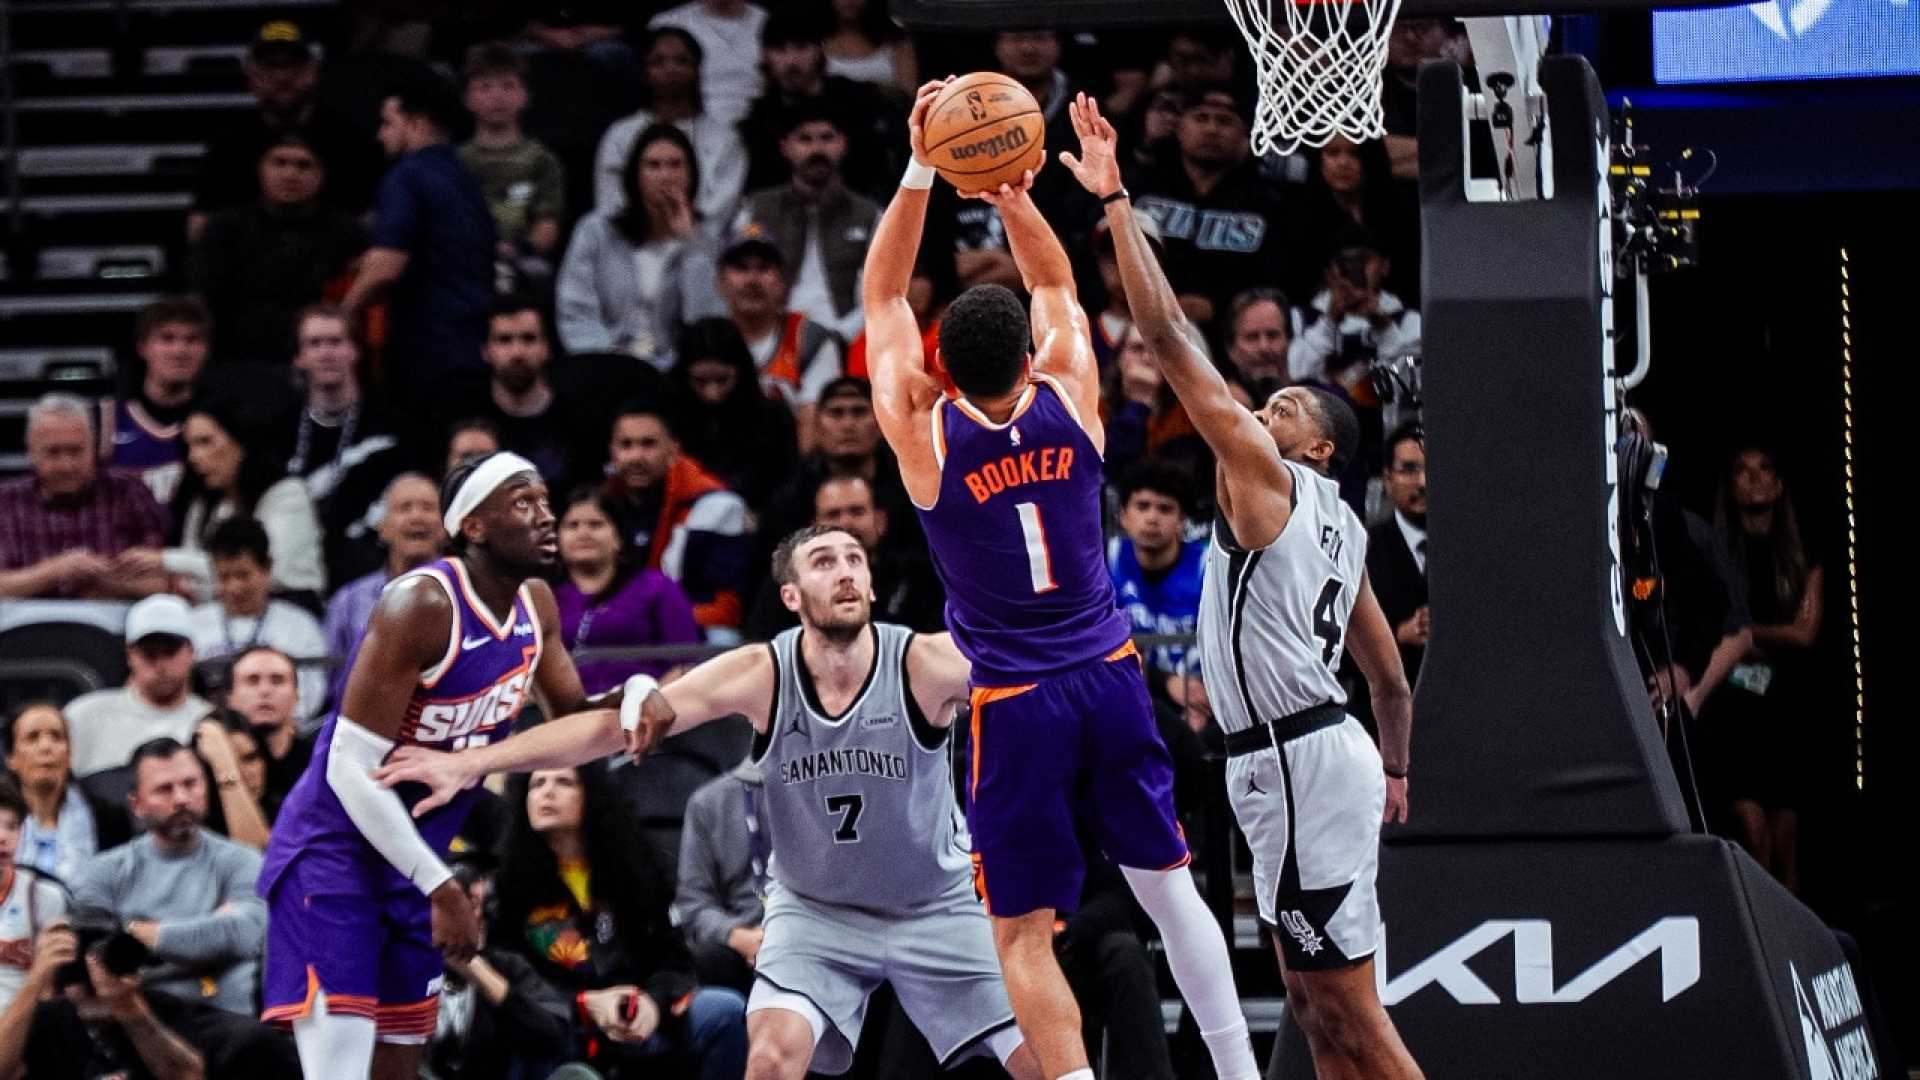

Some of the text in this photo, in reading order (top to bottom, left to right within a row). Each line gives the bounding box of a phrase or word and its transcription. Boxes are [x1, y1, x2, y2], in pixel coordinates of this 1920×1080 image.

[950, 125, 1029, 160] Wilson
[964, 447, 1074, 505] BOOKER
[1014, 502, 1060, 594] 1
[1311, 577, 1345, 672] 4
[825, 794, 865, 844] 7
